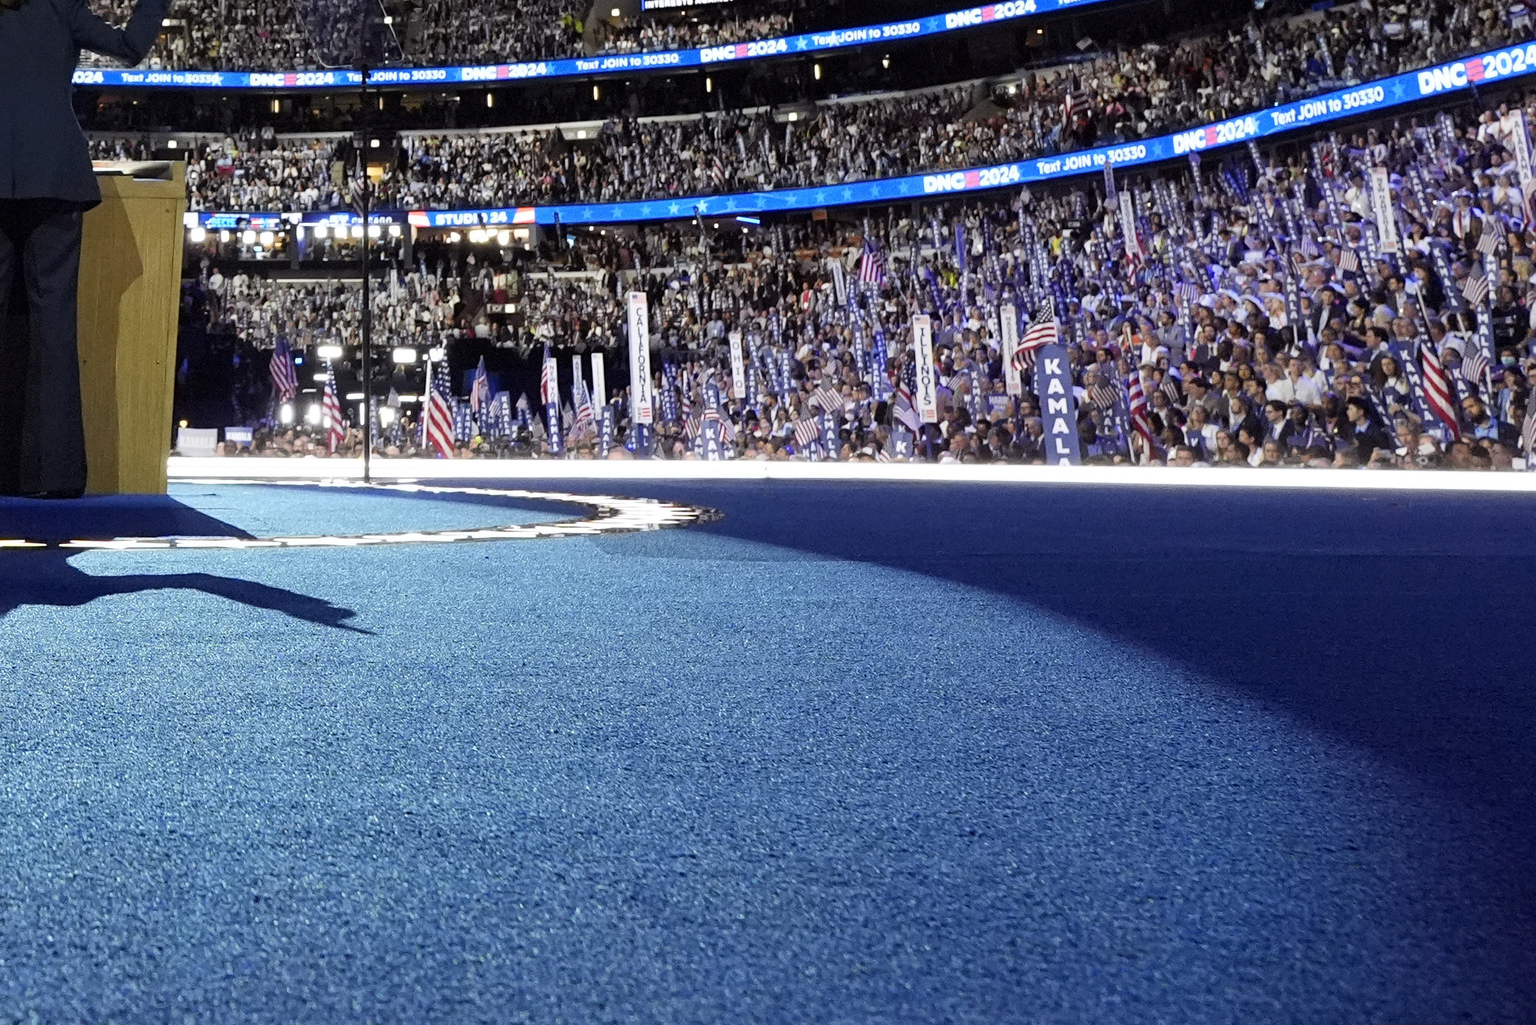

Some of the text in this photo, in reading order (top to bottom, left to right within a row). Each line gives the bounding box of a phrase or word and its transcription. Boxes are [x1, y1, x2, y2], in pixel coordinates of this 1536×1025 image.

[945, 9, 982, 30] DNC
[700, 38, 788, 64] DNC 2024
[121, 73, 184, 83] Text JOIN to
[250, 74, 285, 86] DNC
[296, 72, 334, 85] 2024
[462, 63, 547, 80] DNC 2024
[1417, 45, 1536, 95] DNC 2024
[1271, 85, 1385, 126] Text JOIN to 30330
[1173, 117, 1256, 154] DNC 2024
[1036, 144, 1146, 175] Text JOIN to 30330
[923, 165, 1020, 193] DNC 2024
[636, 307, 647, 403] CALIFORNIA
[732, 342, 743, 389] OHIO
[920, 327, 932, 406] ILLINOIS
